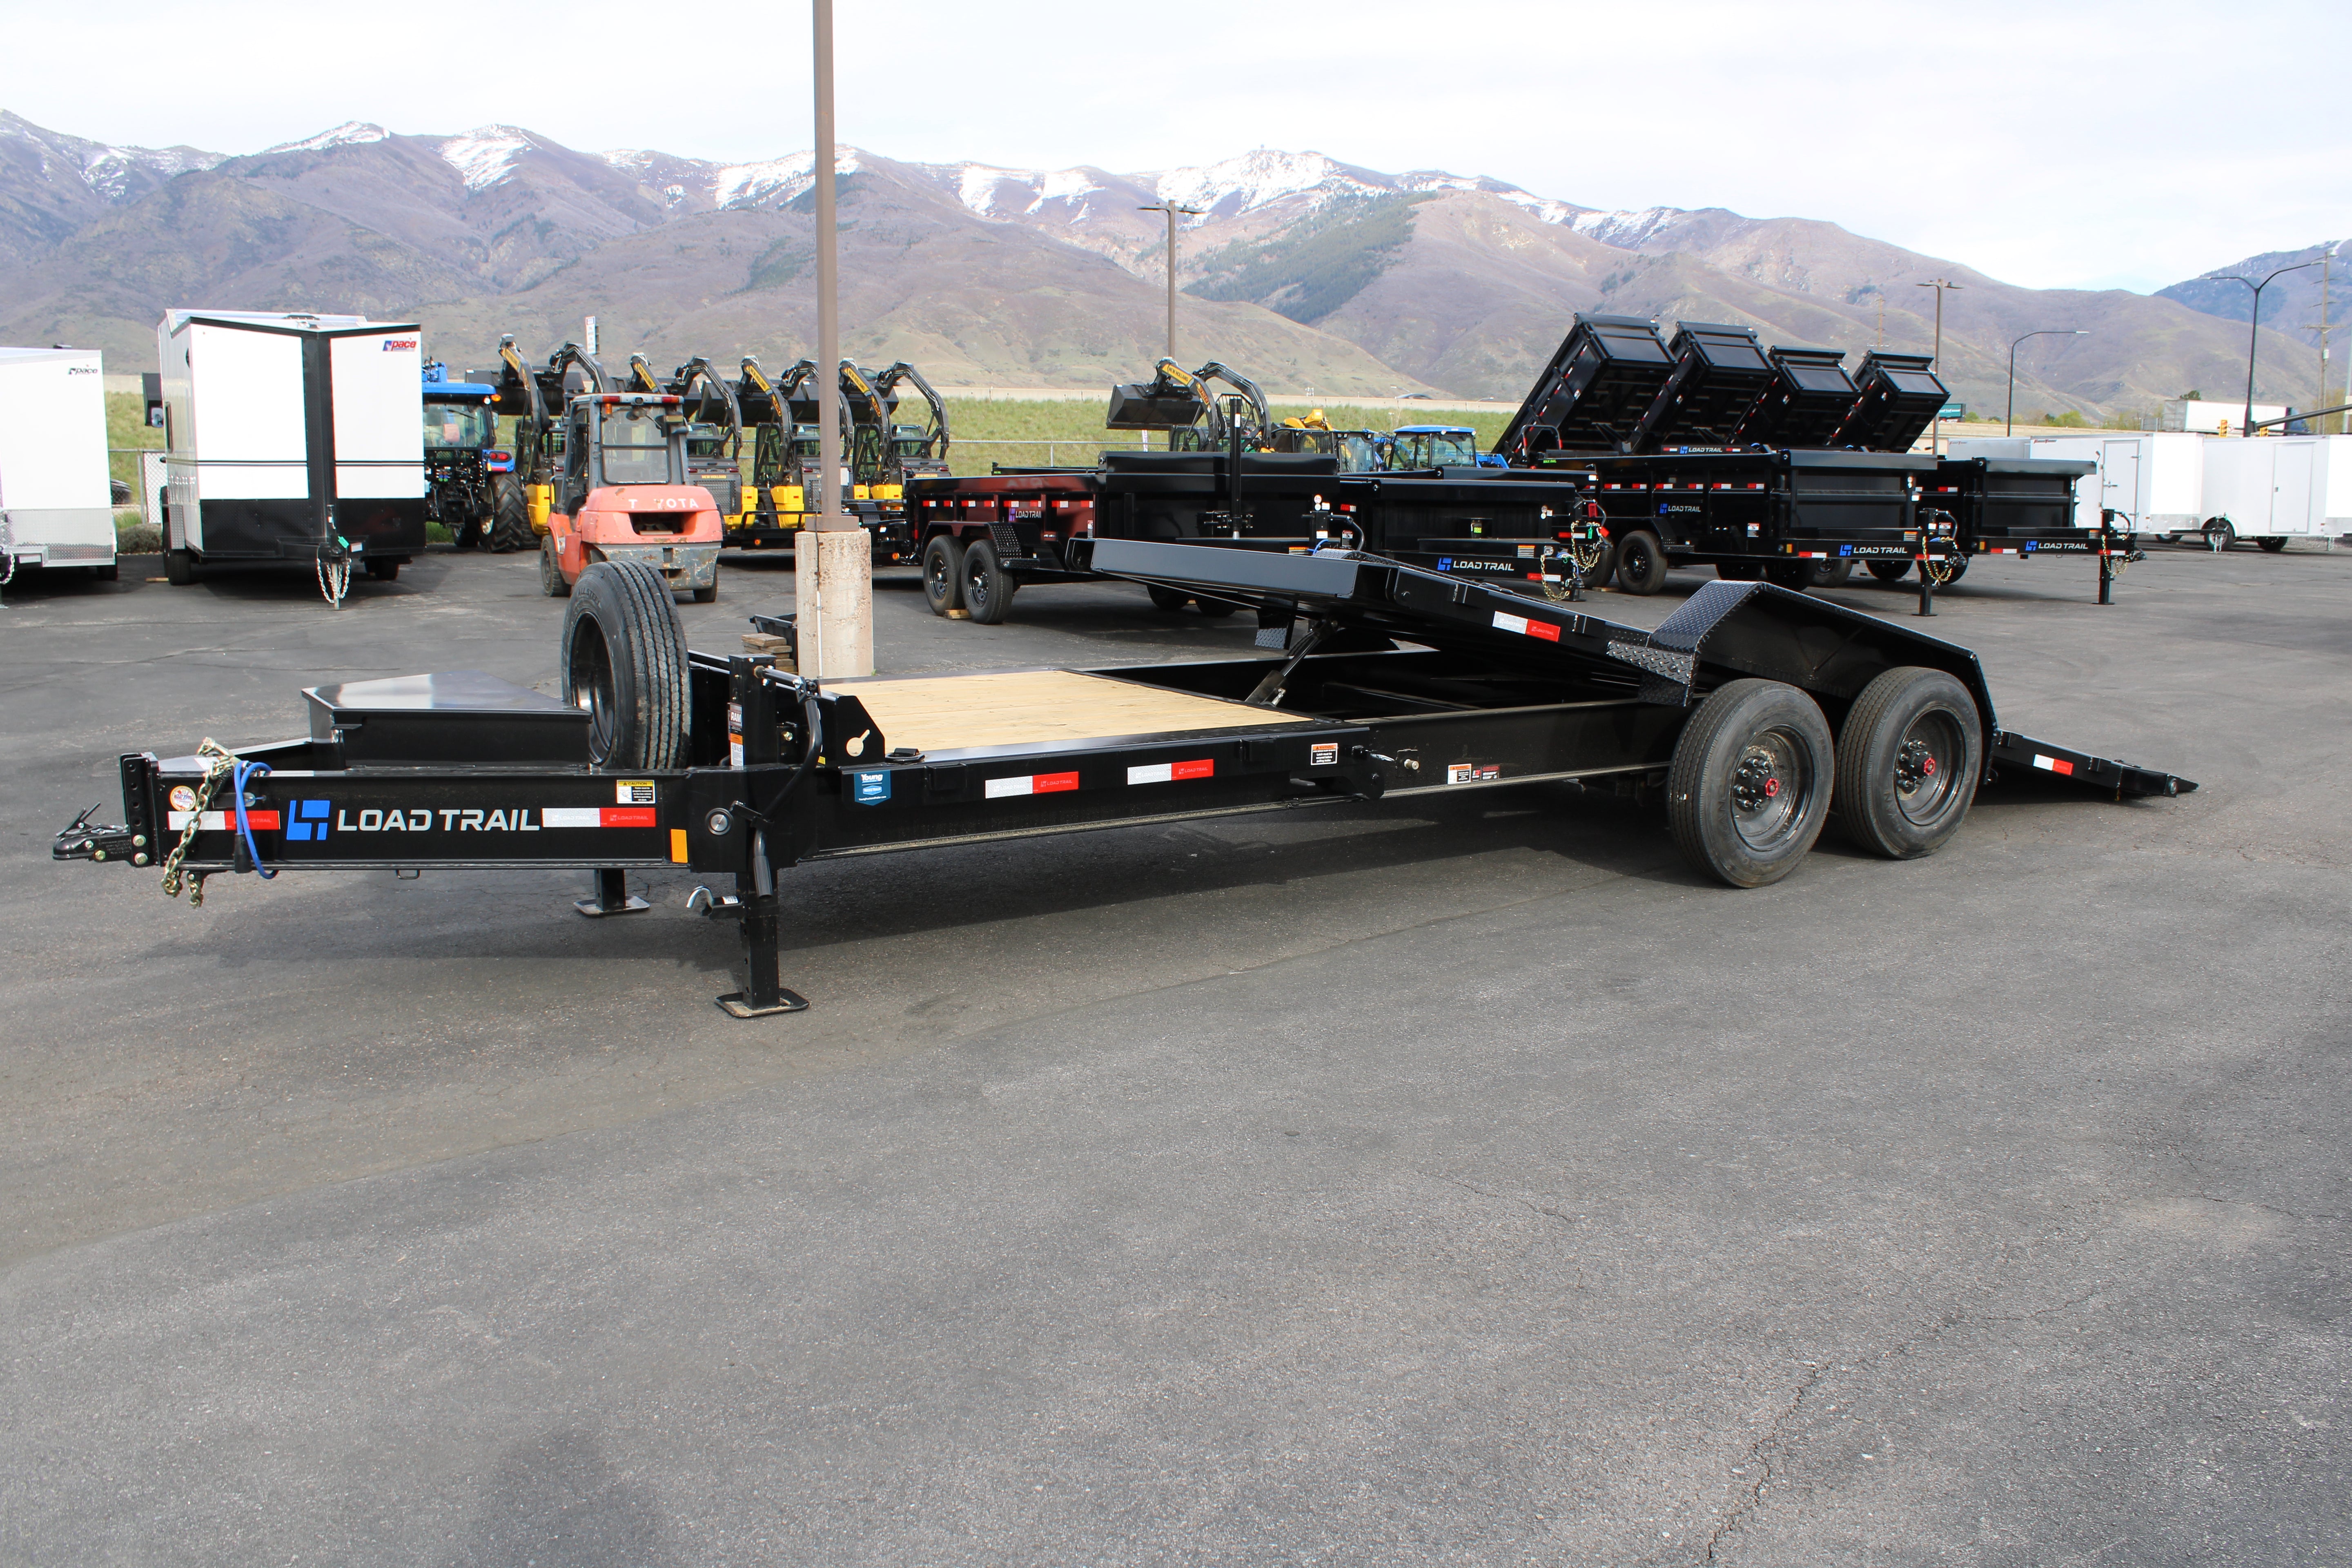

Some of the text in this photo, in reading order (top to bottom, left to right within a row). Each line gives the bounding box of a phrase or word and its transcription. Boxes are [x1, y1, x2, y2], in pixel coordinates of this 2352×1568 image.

[1175, 370, 1189, 381] HOLLAND
[1453, 561, 1515, 571] LOAD TRAIL
[731, 711, 742, 723] RAM
[337, 809, 540, 831] LOAD TRAIL
